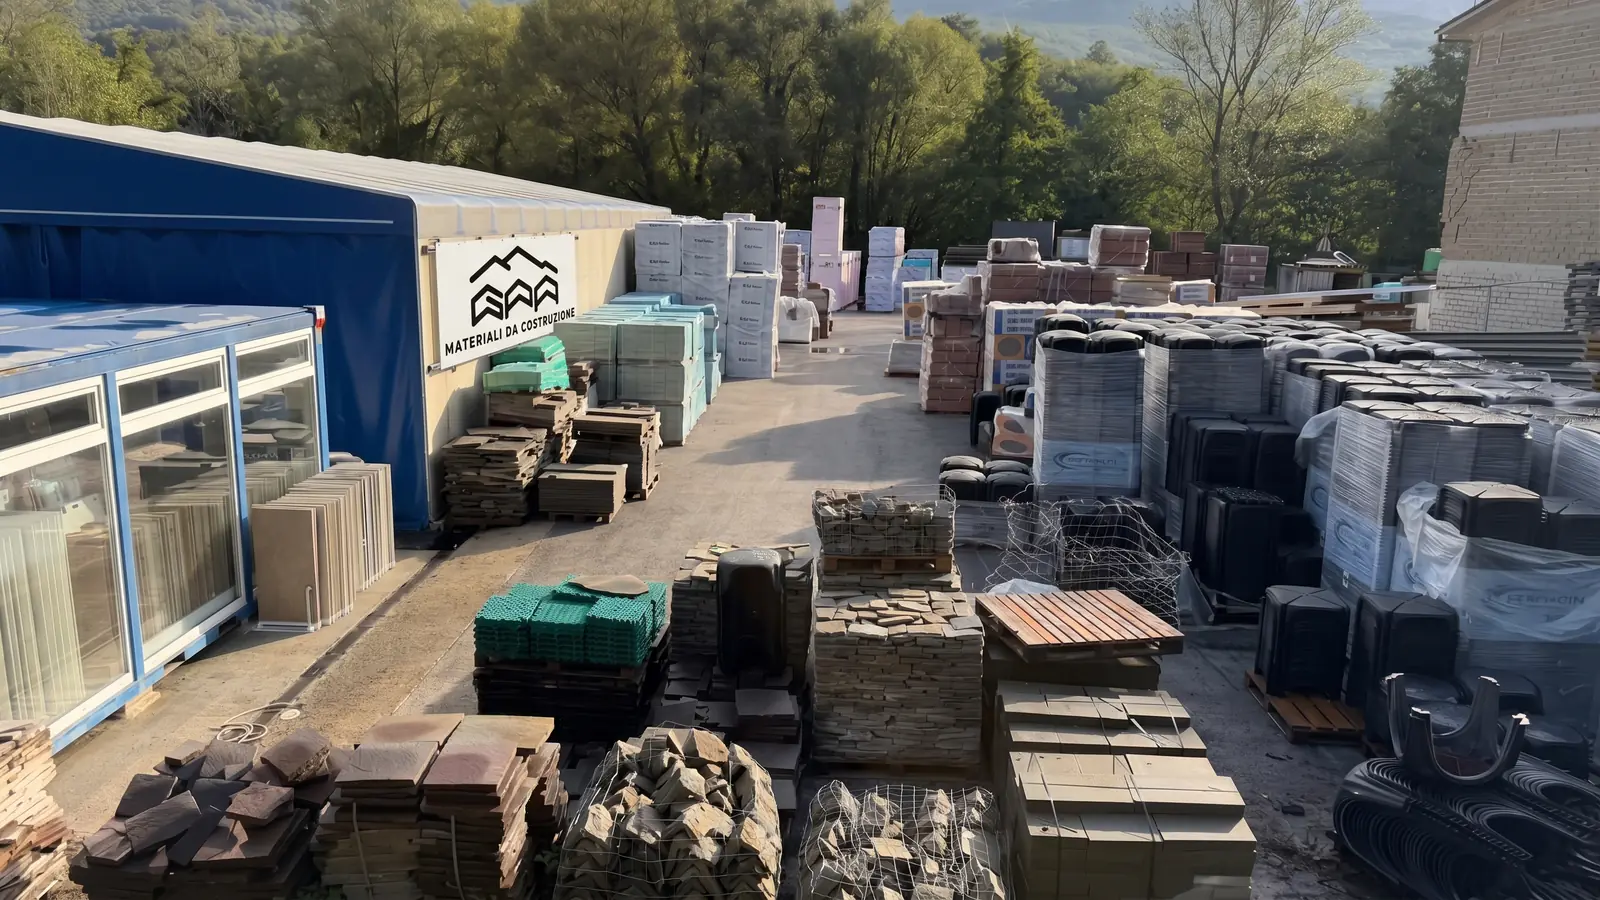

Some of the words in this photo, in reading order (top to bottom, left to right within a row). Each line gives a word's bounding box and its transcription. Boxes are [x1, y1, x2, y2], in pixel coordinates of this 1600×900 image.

[445, 328, 503, 356] MATERIALI
[505, 324, 518, 338] DA
[521, 307, 576, 332] COSTRUZIONE
